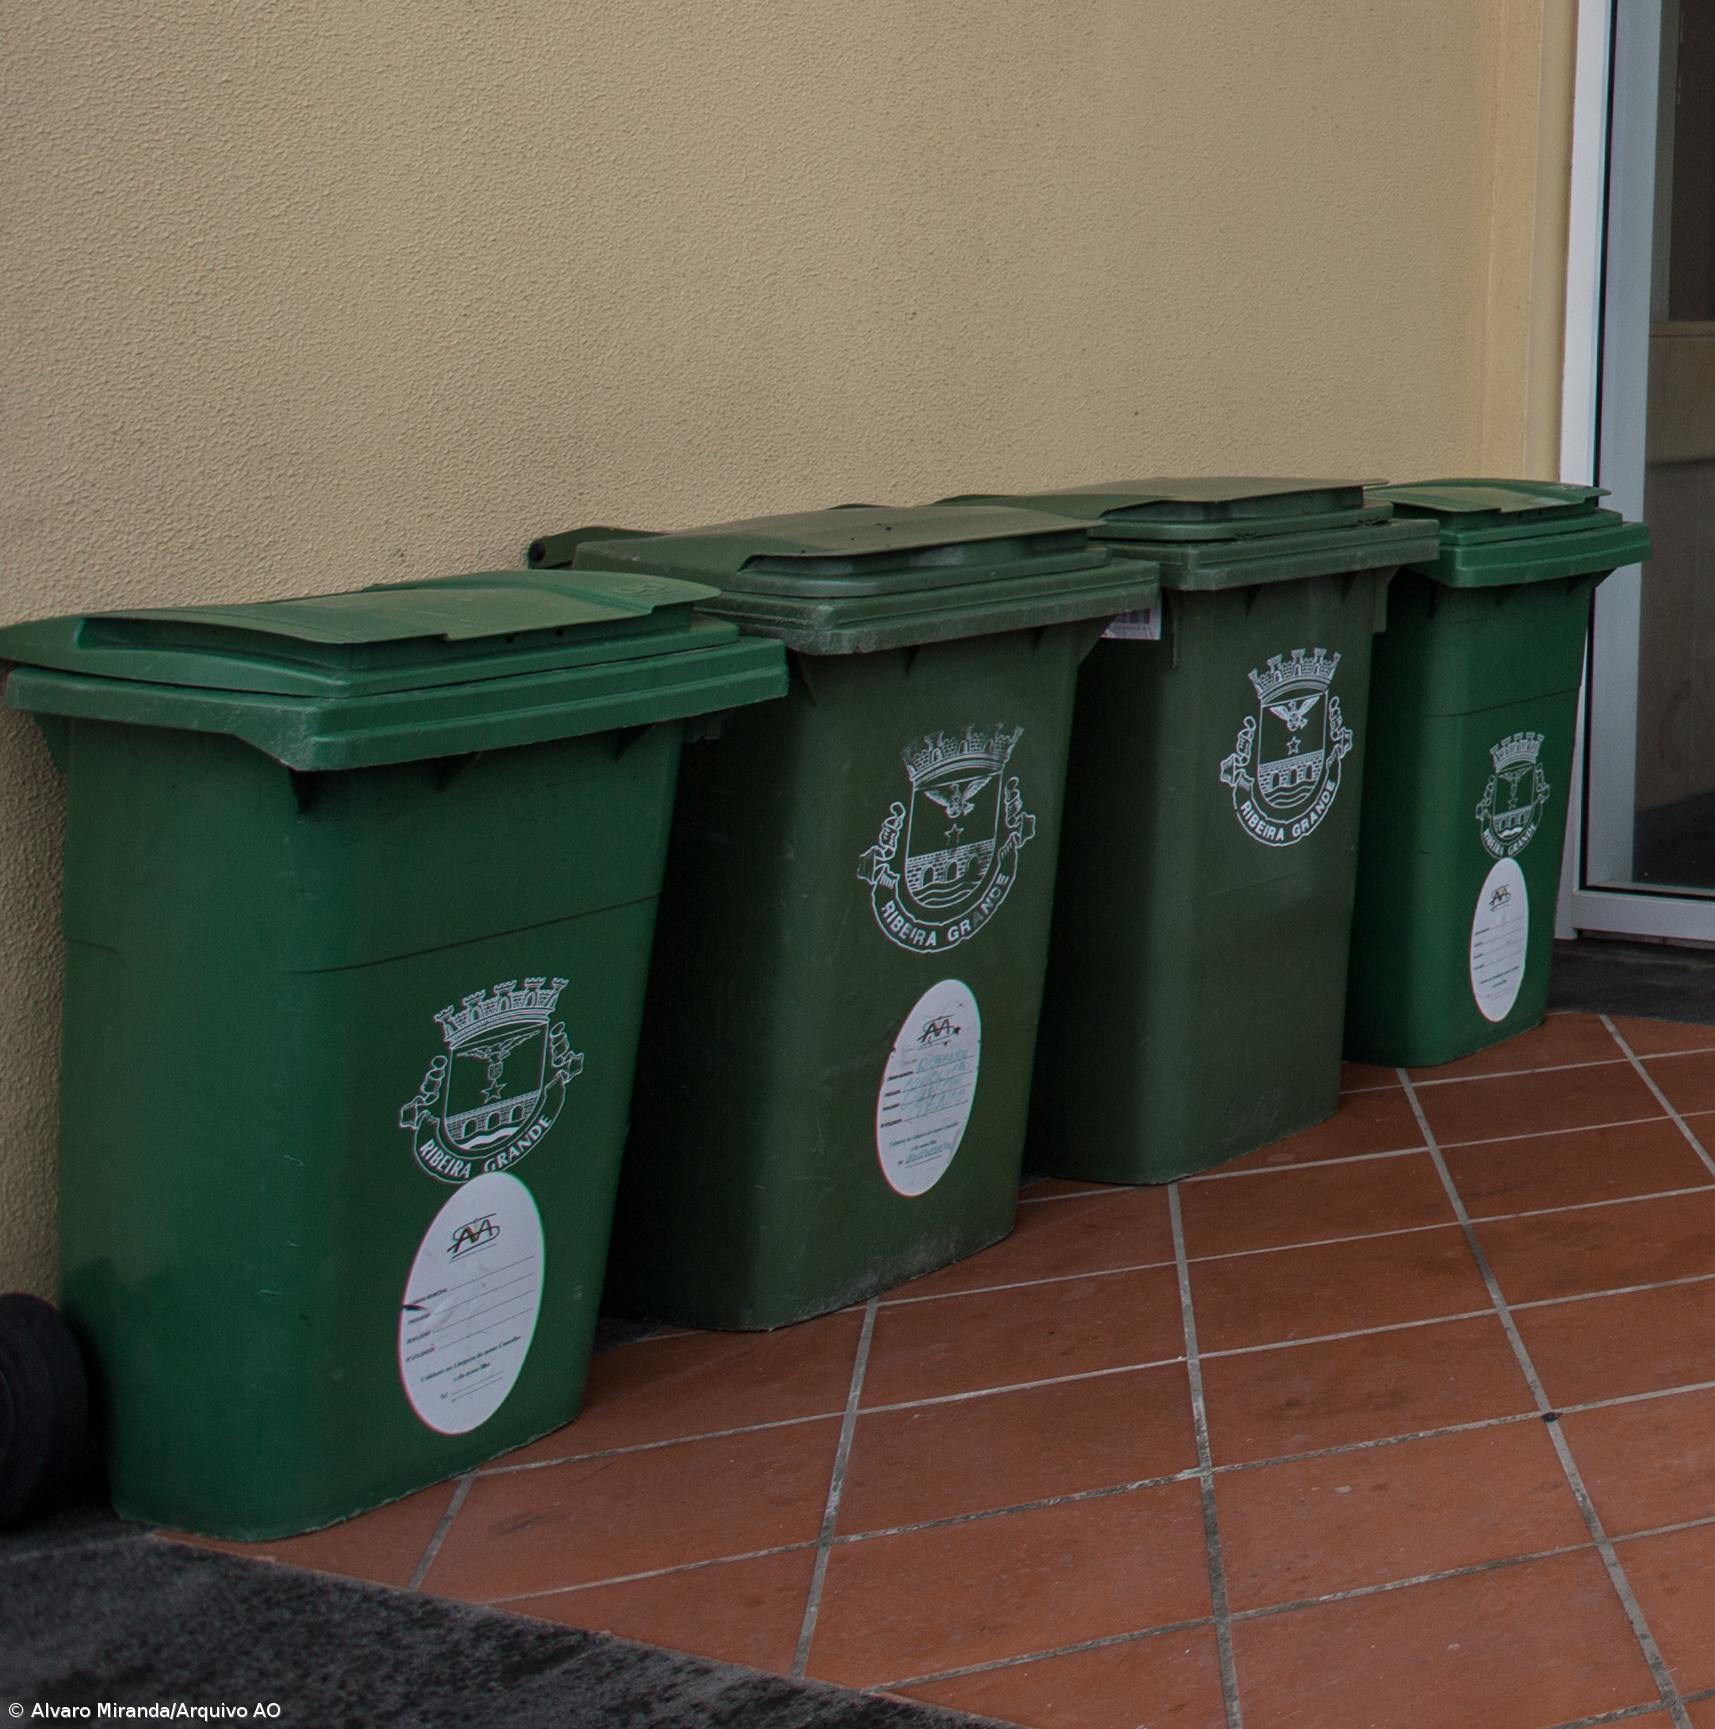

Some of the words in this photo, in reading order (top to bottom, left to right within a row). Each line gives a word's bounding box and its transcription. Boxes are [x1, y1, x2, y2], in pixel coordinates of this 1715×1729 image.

[1240, 800, 1285, 841] RIBEIRA
[1291, 779, 1336, 837] GRANDE
[881, 900, 937, 947] RIBEIRA
[946, 874, 1010, 942] GRANDE
[420, 1138, 472, 1179] RIBEIRA
[483, 1115, 552, 1172] GRANDE
